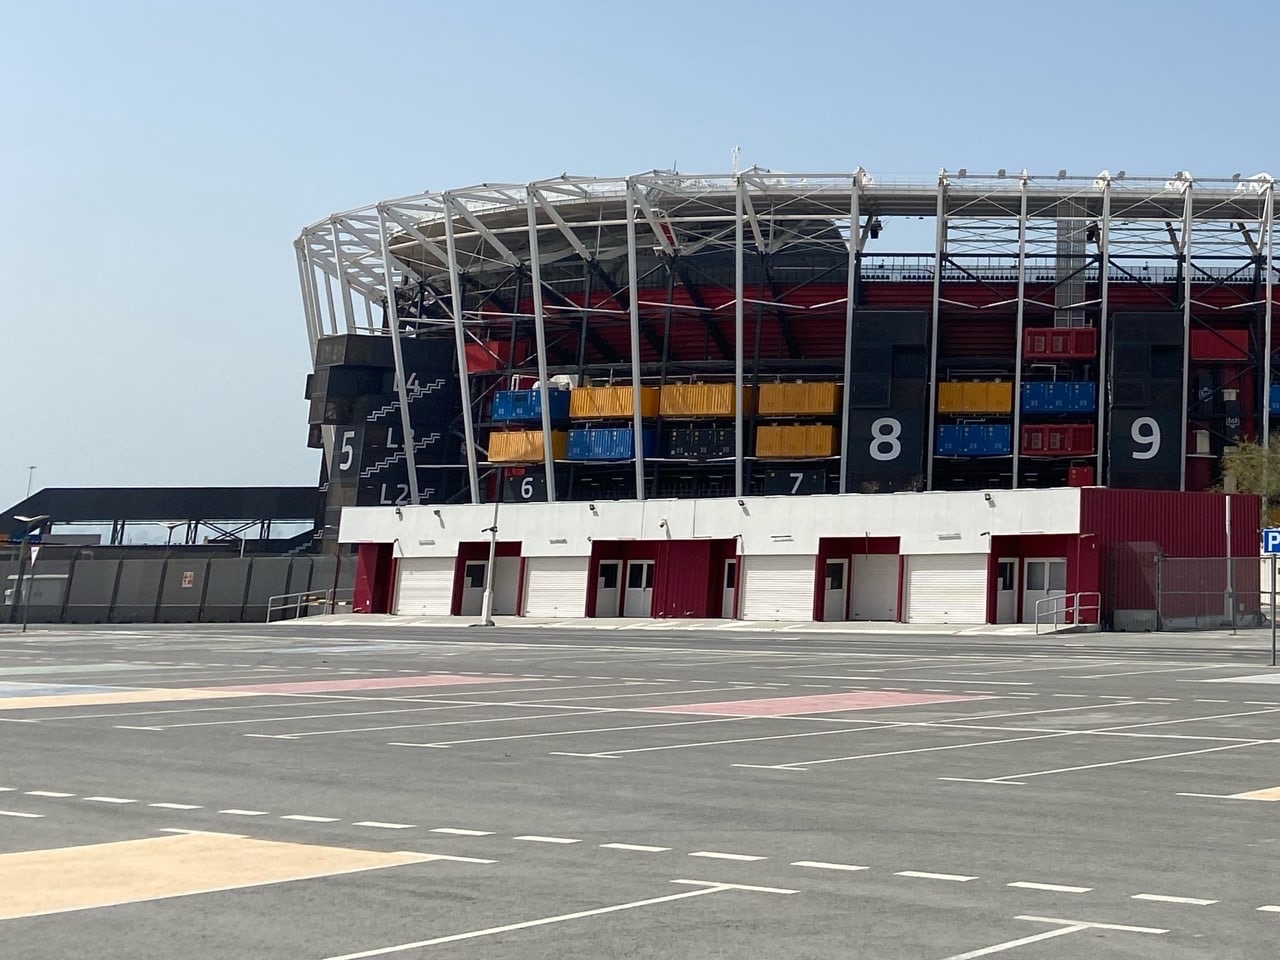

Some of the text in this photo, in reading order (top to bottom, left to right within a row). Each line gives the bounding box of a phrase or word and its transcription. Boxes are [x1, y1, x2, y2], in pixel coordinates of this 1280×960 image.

[869, 417, 902, 461] 8
[1130, 416, 1161, 460] 9
[339, 430, 355, 471] 5
[380, 483, 413, 505] L2
[521, 477, 533, 499] 6
[789, 472, 804, 494] 7
[1267, 531, 1280, 552] P
